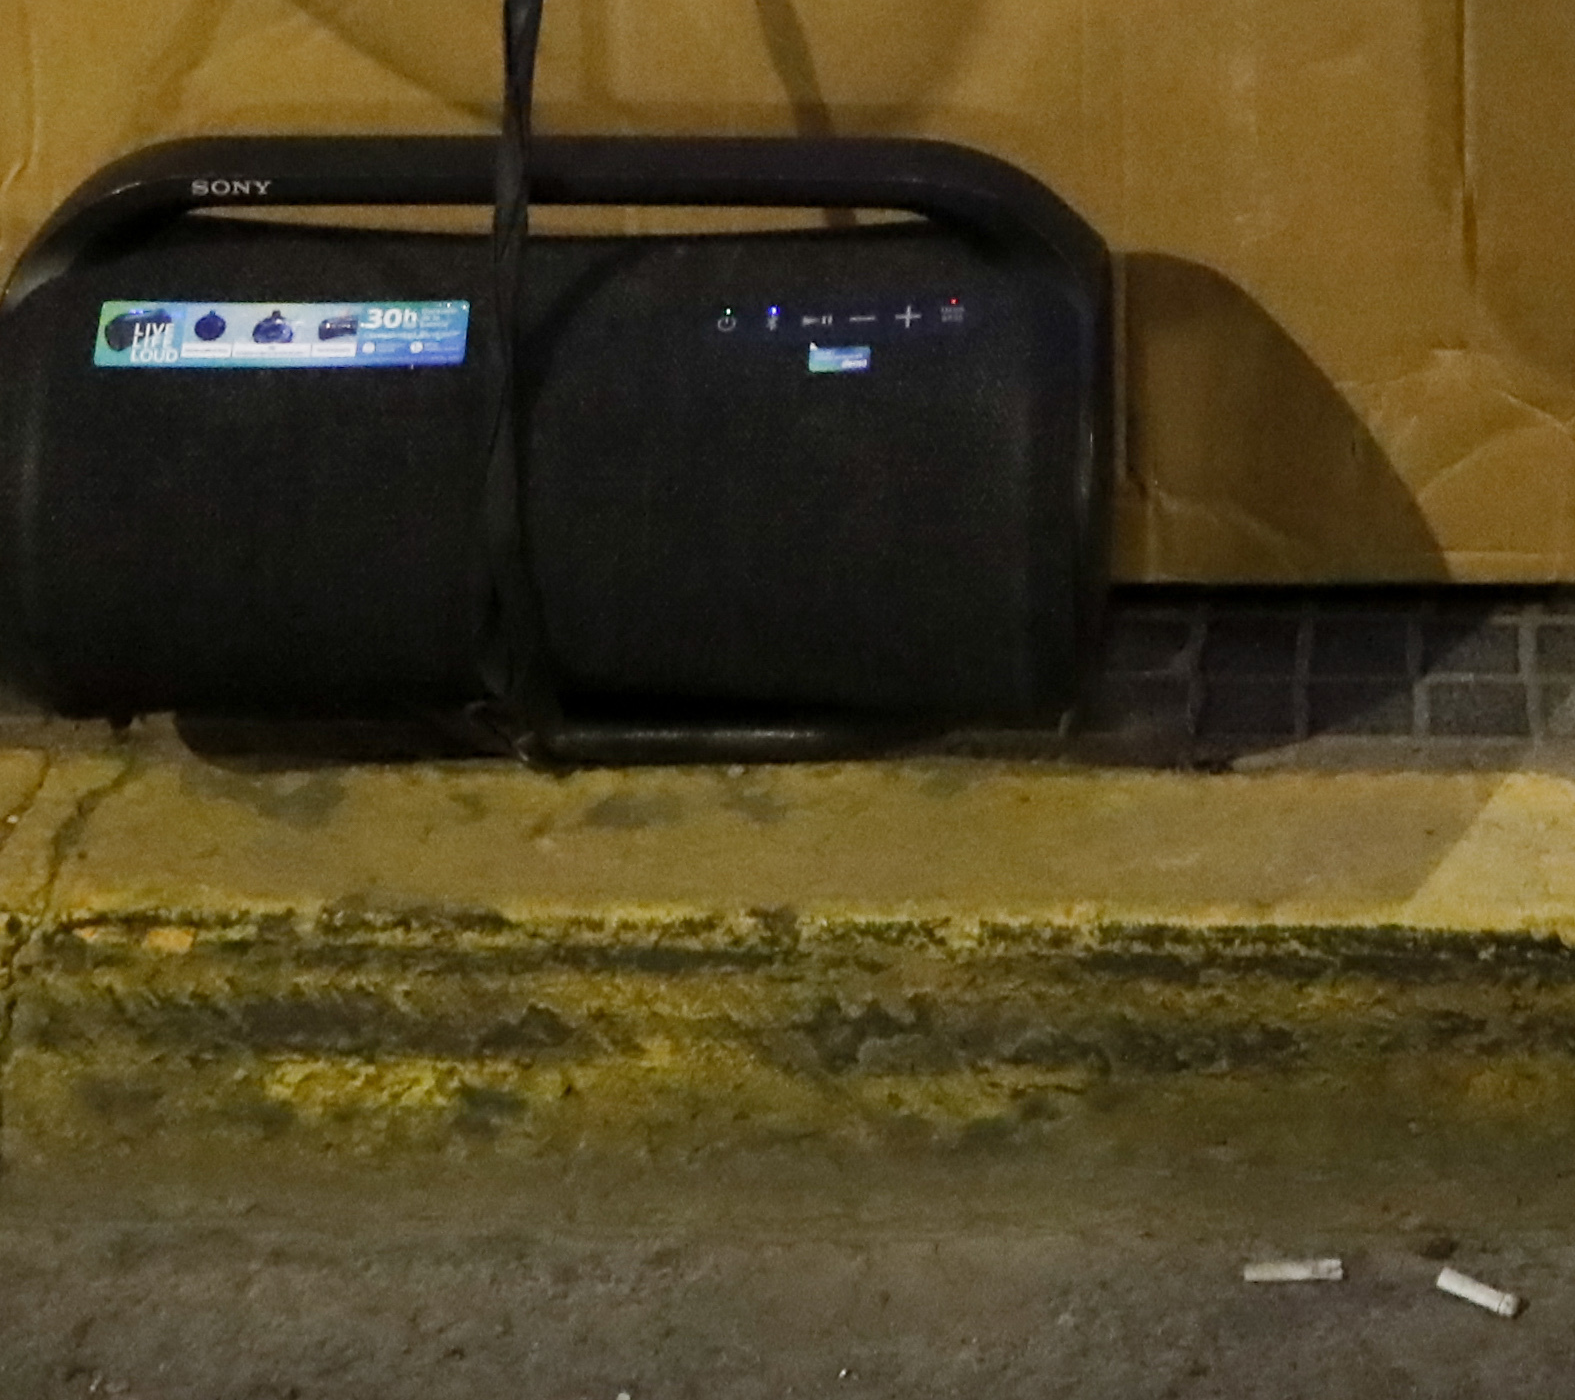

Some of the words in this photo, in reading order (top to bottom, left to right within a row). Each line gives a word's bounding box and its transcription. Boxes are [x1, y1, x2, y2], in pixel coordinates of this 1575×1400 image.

[191, 179, 272, 196] SONY
[366, 307, 418, 329] 30h
[133, 322, 175, 337] LIVE
[130, 349, 179, 363] LOUD
